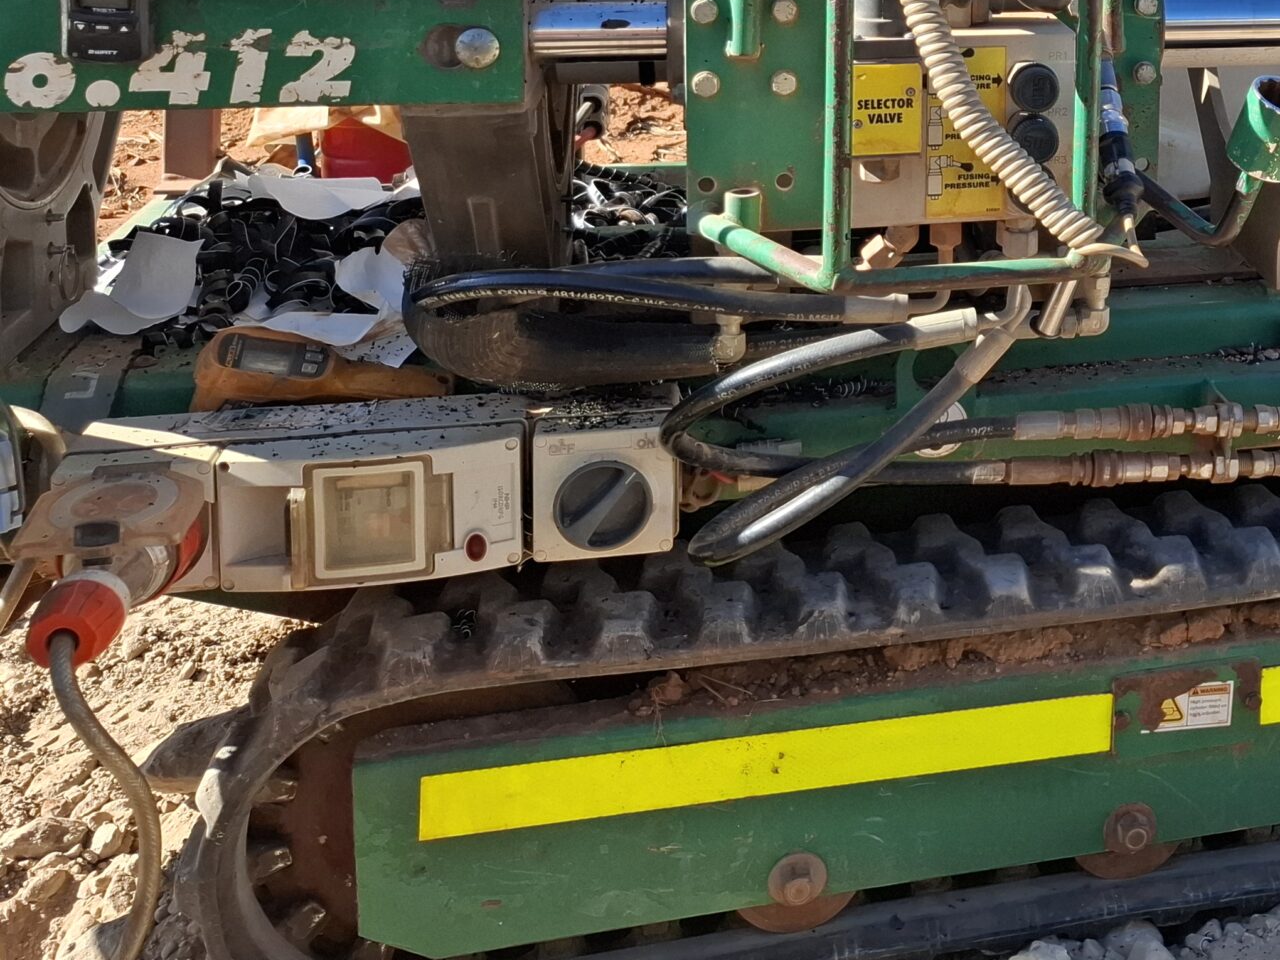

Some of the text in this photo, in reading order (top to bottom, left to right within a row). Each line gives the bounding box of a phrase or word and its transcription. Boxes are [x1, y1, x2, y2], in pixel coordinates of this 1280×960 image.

[1049, 51, 1068, 61] PR1
[857, 98, 914, 110] SELECTOR
[868, 112, 903, 124] VALVE
[957, 173, 991, 181] FUSING
[944, 182, 990, 190] PRESSURE
[549, 438, 656, 455] OFF ON
